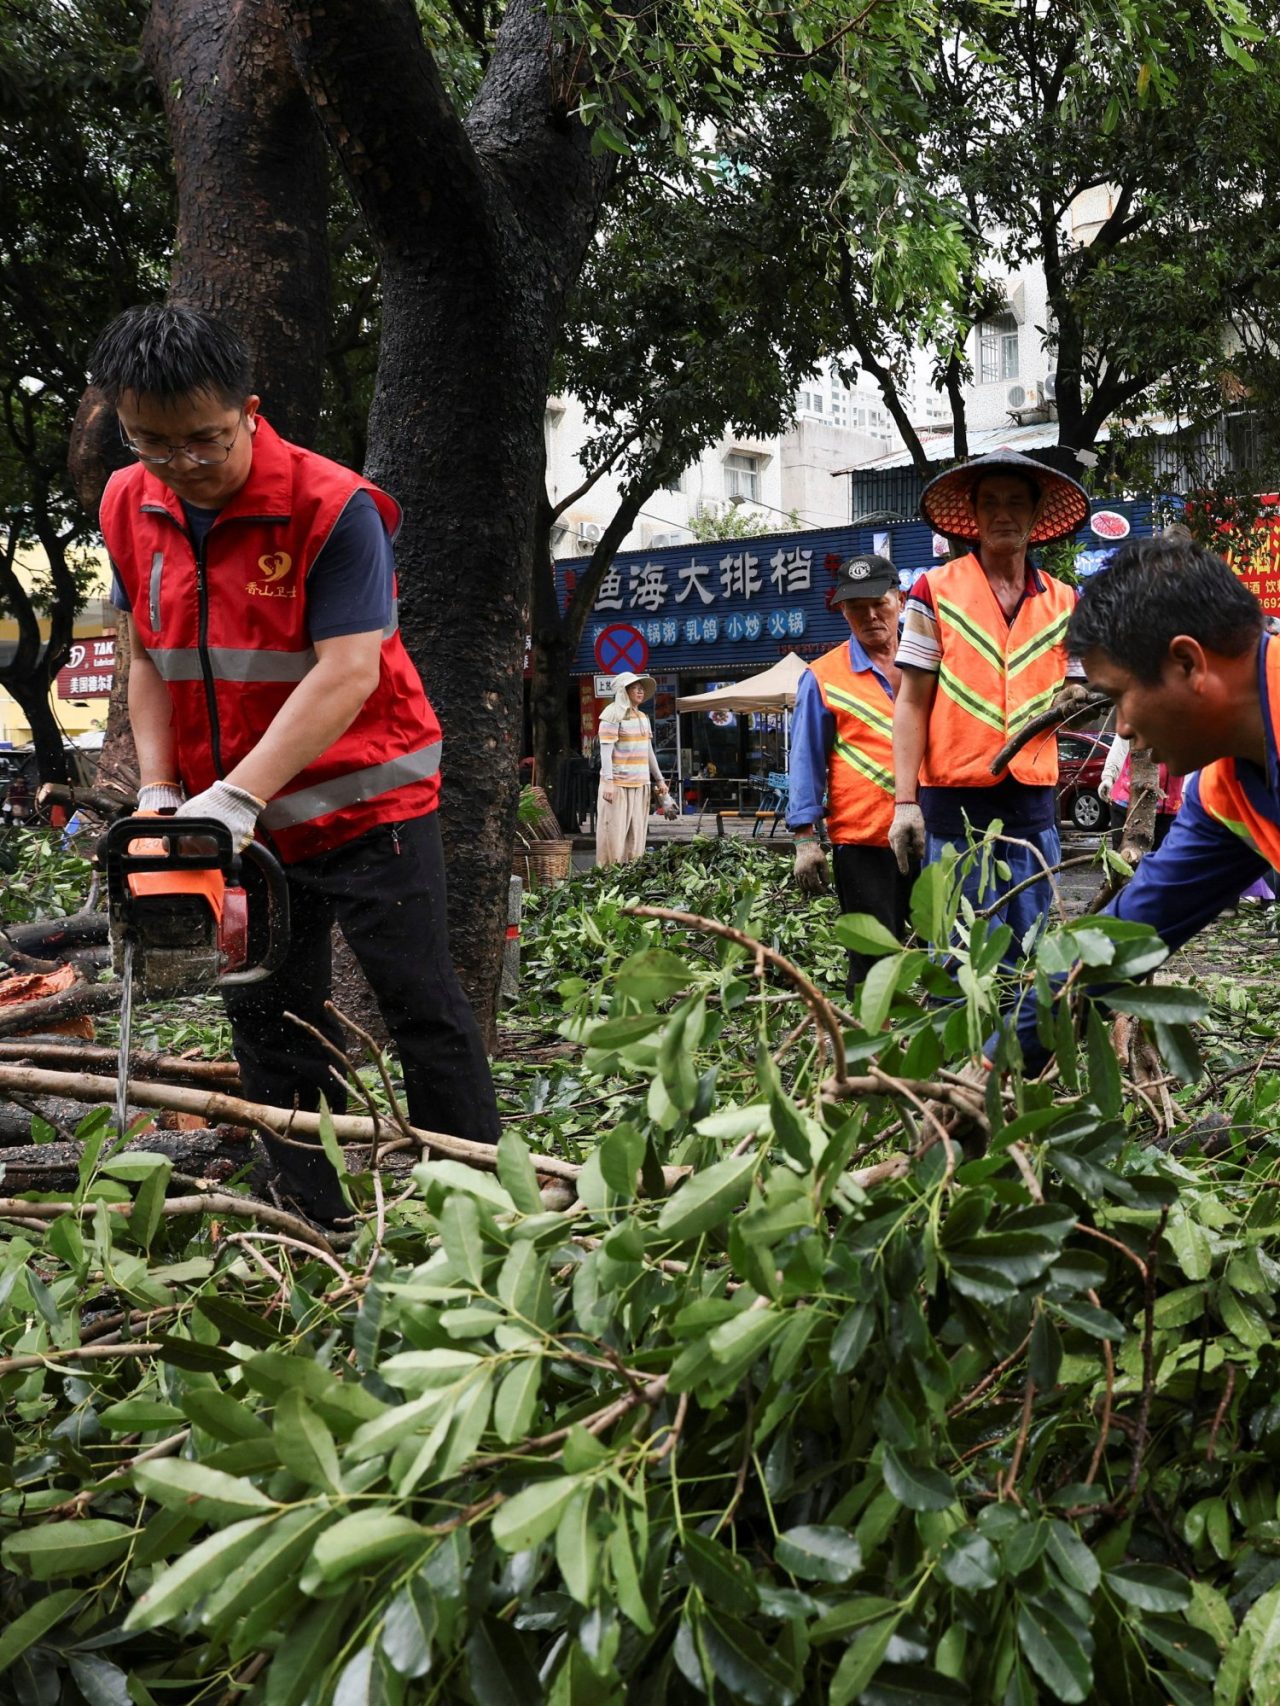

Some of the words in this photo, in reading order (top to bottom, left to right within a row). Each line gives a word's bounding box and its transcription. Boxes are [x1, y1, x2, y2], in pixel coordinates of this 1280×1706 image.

[686, 618, 718, 640] 乳鸽
[729, 614, 760, 637] 小炒
[771, 611, 804, 635] 火锅
